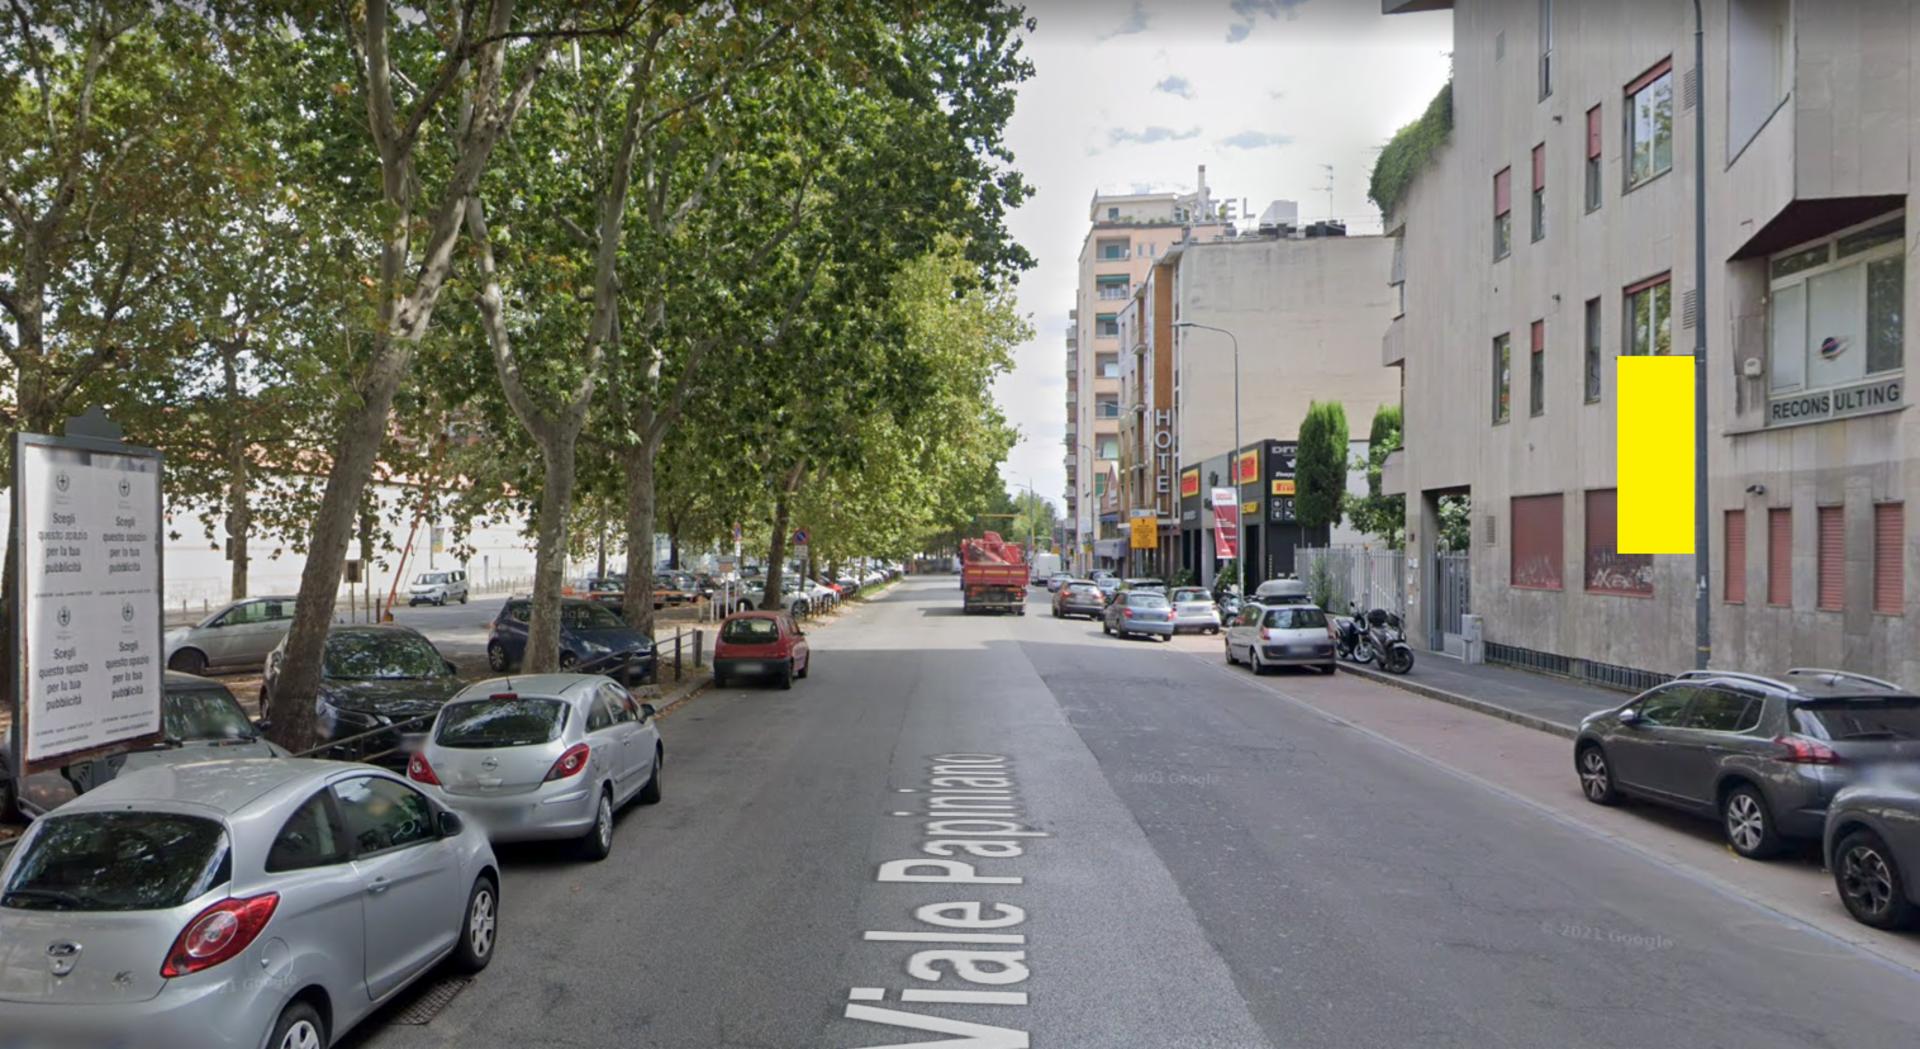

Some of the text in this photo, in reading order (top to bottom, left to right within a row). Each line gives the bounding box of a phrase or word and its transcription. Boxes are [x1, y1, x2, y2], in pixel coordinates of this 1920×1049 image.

[1154, 409, 1172, 515] HOTEL
[52, 512, 76, 526] Scegli
[115, 516, 136, 529] Scegli
[46, 547, 59, 559] per
[109, 547, 121, 559] per
[119, 640, 139, 653] Scegli
[53, 647, 77, 661] Scegli
[112, 674, 124, 685] per
[46, 683, 60, 695] per
[46, 694, 82, 712] pubblicità
[845, 753, 1050, 1049] Viale Papiniano
